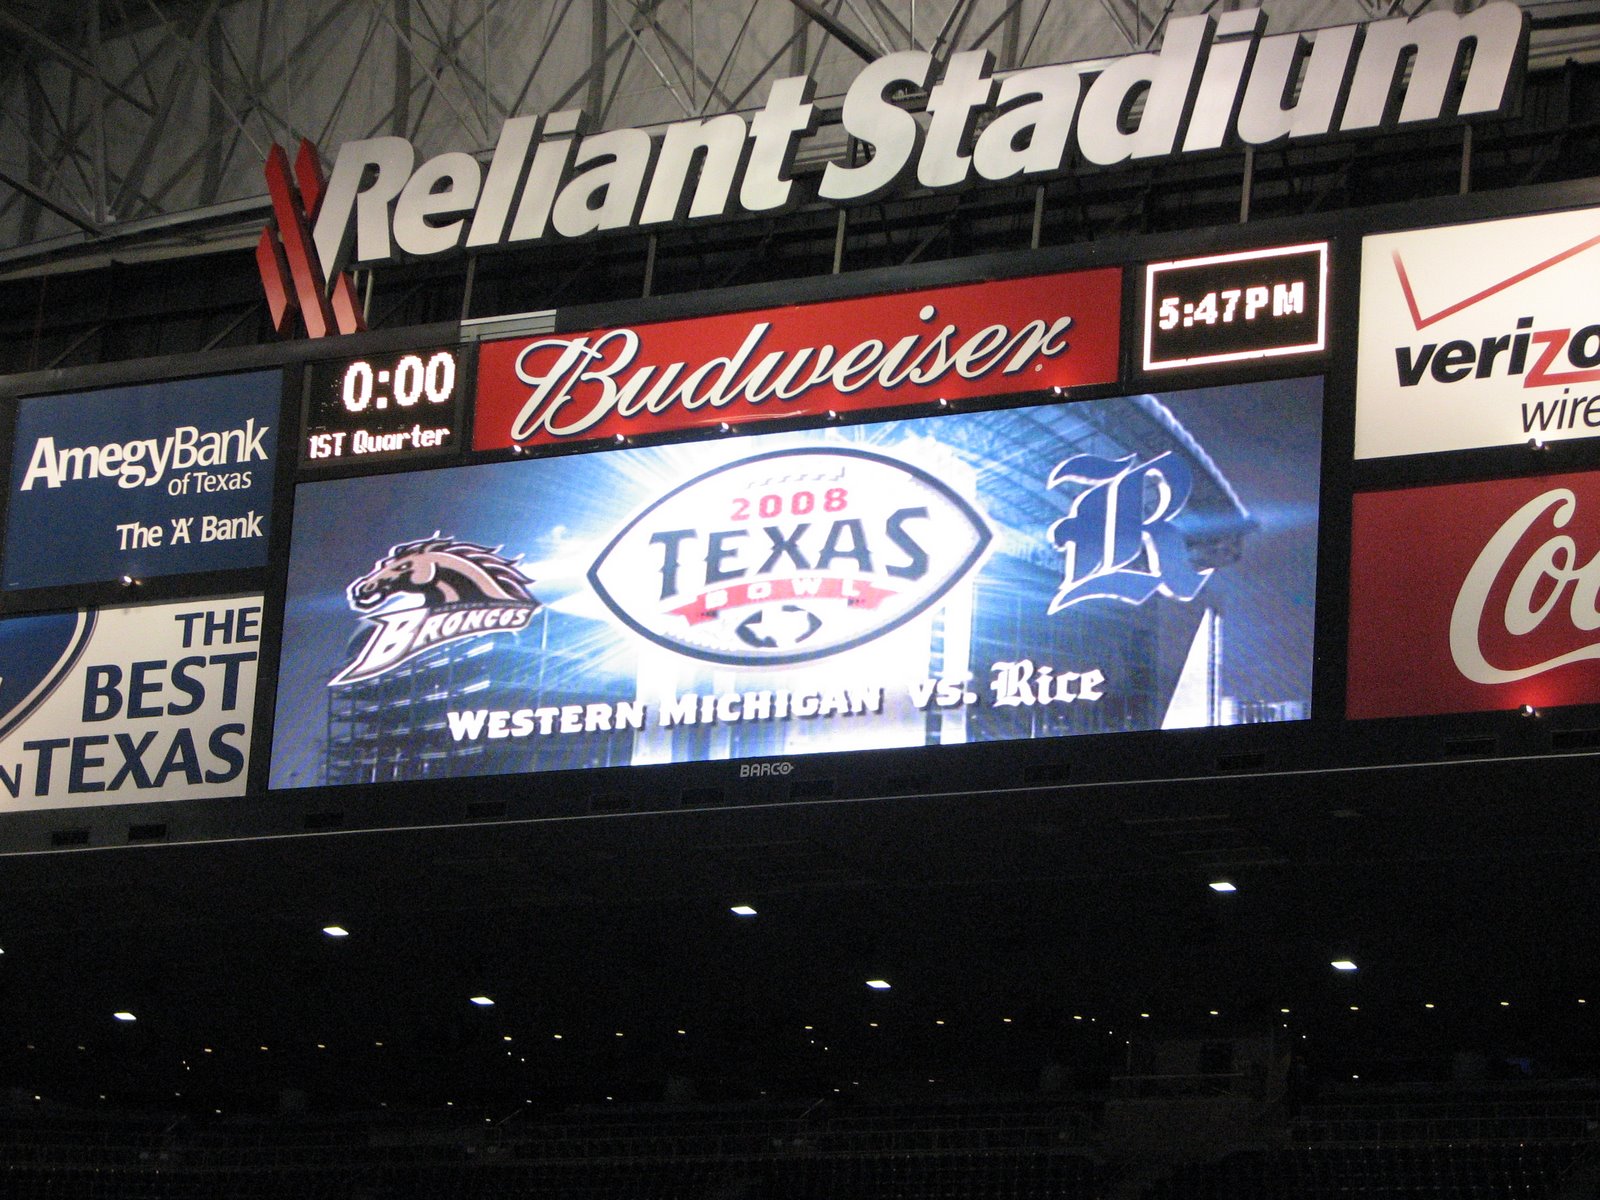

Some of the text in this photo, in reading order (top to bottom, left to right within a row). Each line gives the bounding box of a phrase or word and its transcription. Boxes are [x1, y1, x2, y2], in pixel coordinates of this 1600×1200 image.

[313, 2, 1528, 283] Reliant Stadium
[343, 352, 455, 412] 0:00
[510, 304, 1072, 441] Budweiser
[1395, 316, 1600, 389] verizo
[1521, 388, 1600, 433] wire
[20, 417, 270, 490] AmegyBank
[309, 424, 450, 459] 1ST Quarter
[168, 471, 252, 496] of Texas
[730, 487, 849, 522] 2008
[116, 521, 163, 550] The
[200, 510, 264, 542] Bank
[648, 506, 930, 601] TEXAS
[703, 576, 861, 610] BOWL
[175, 606, 261, 648] THE
[82, 651, 258, 723] BEST
[446, 701, 646, 742] WESTERN
[659, 687, 885, 729] MICHIGAN
[990, 659, 1106, 708] Rice
[23, 723, 246, 797] TEXAS
[740, 761, 794, 778] BARCO
